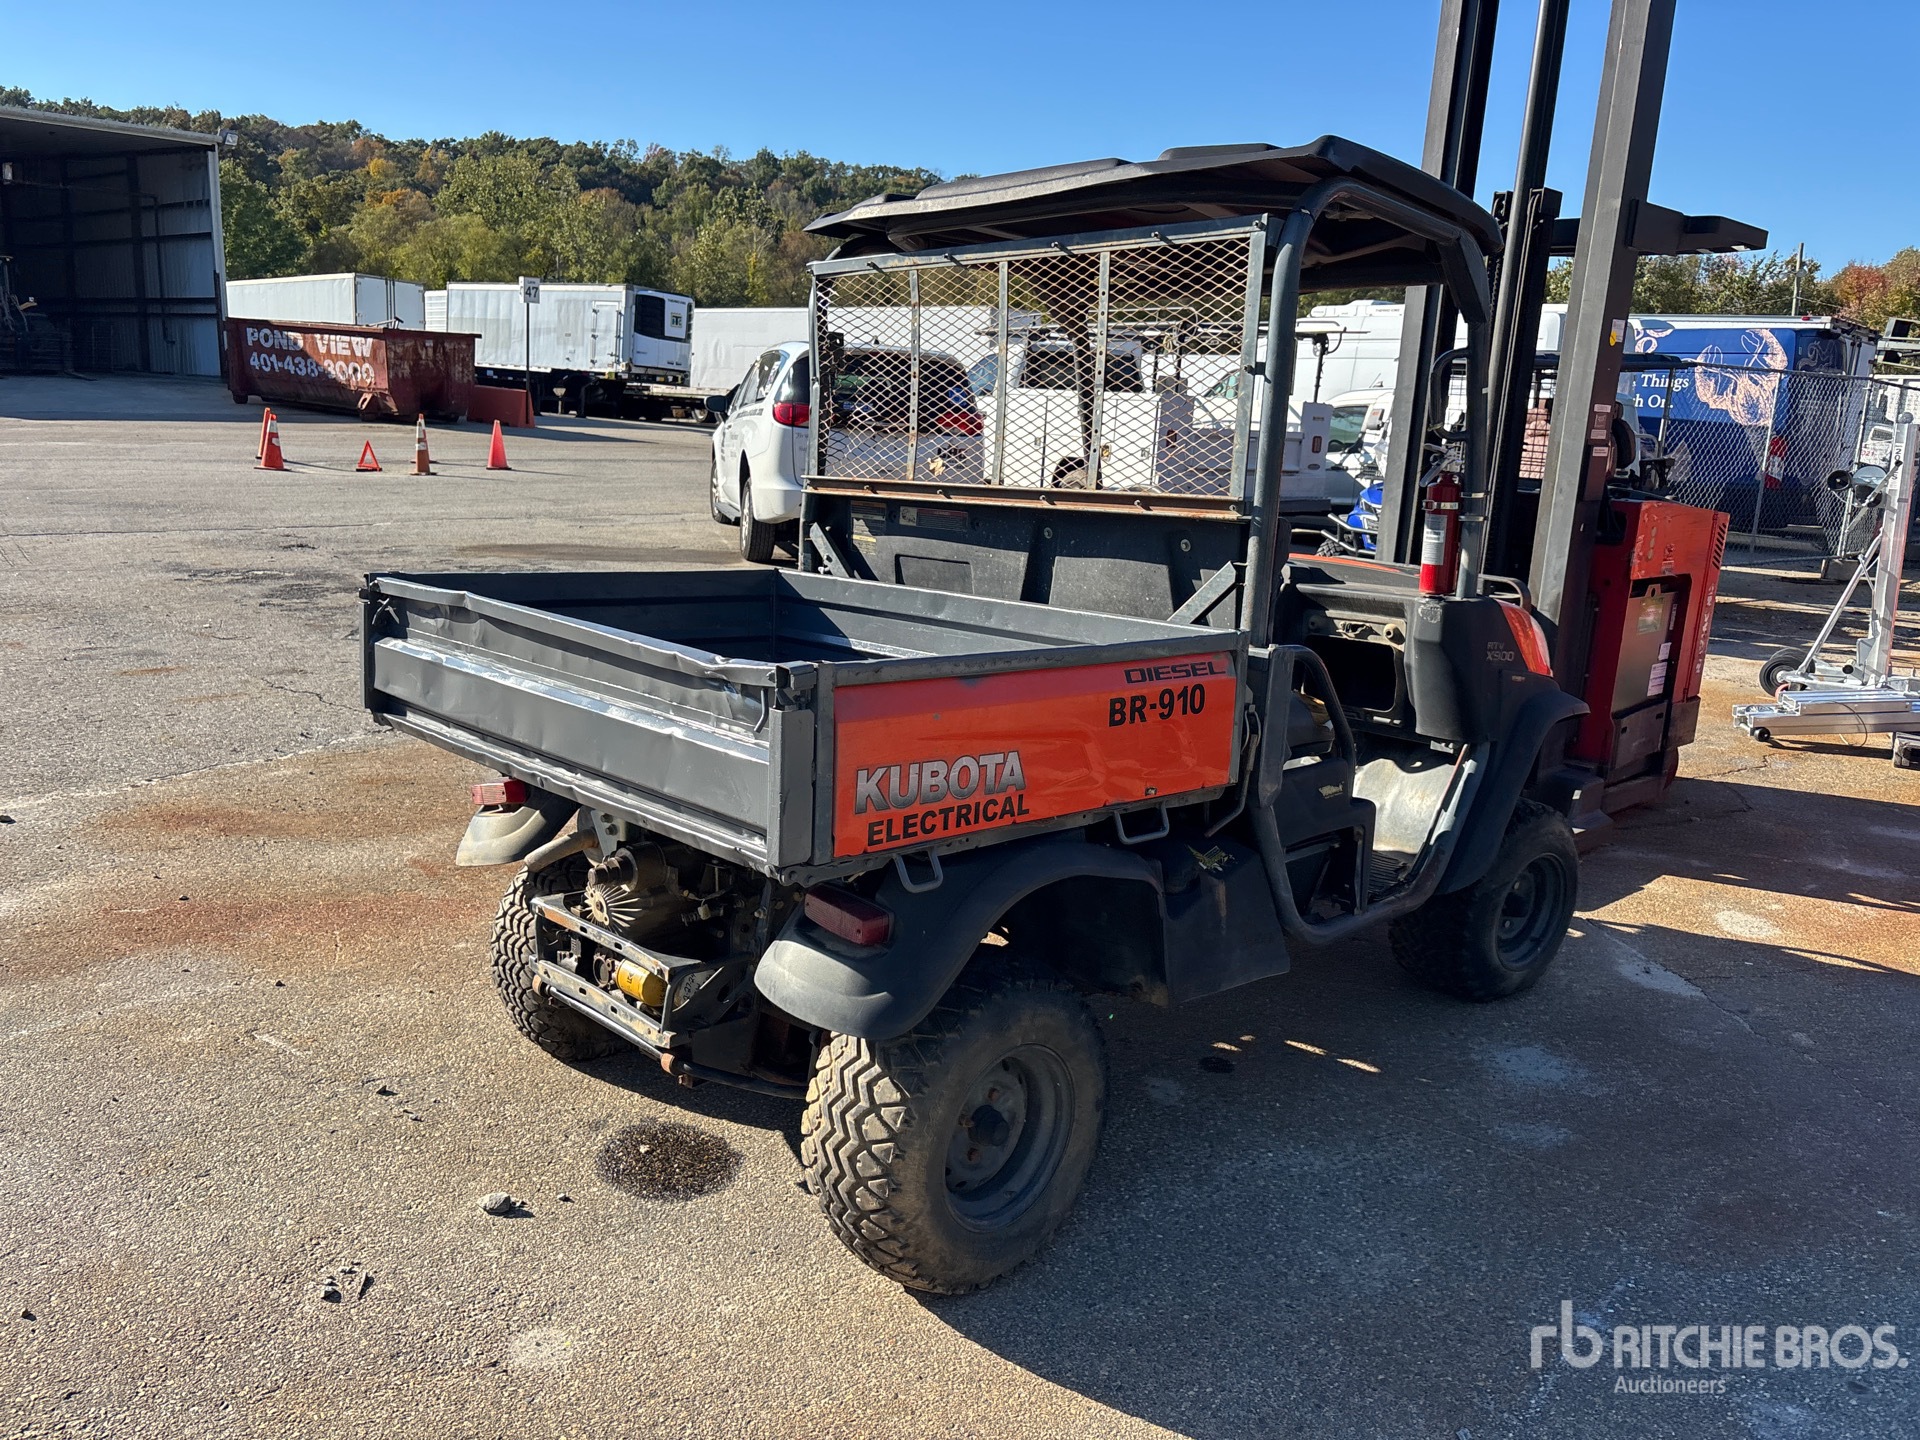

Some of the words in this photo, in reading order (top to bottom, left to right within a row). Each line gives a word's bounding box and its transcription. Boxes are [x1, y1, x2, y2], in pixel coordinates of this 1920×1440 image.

[525, 286, 539, 298] 47
[246, 327, 304, 351] POND
[314, 333, 374, 357] VIEW
[250, 351, 375, 384] 401-438-3000
[1486, 651, 1515, 662] X900
[1124, 661, 1227, 684] DIESEL
[1108, 683, 1206, 727] BR-910
[855, 750, 1026, 815] KUBOTA
[867, 794, 1030, 847] ELECTRICAL
